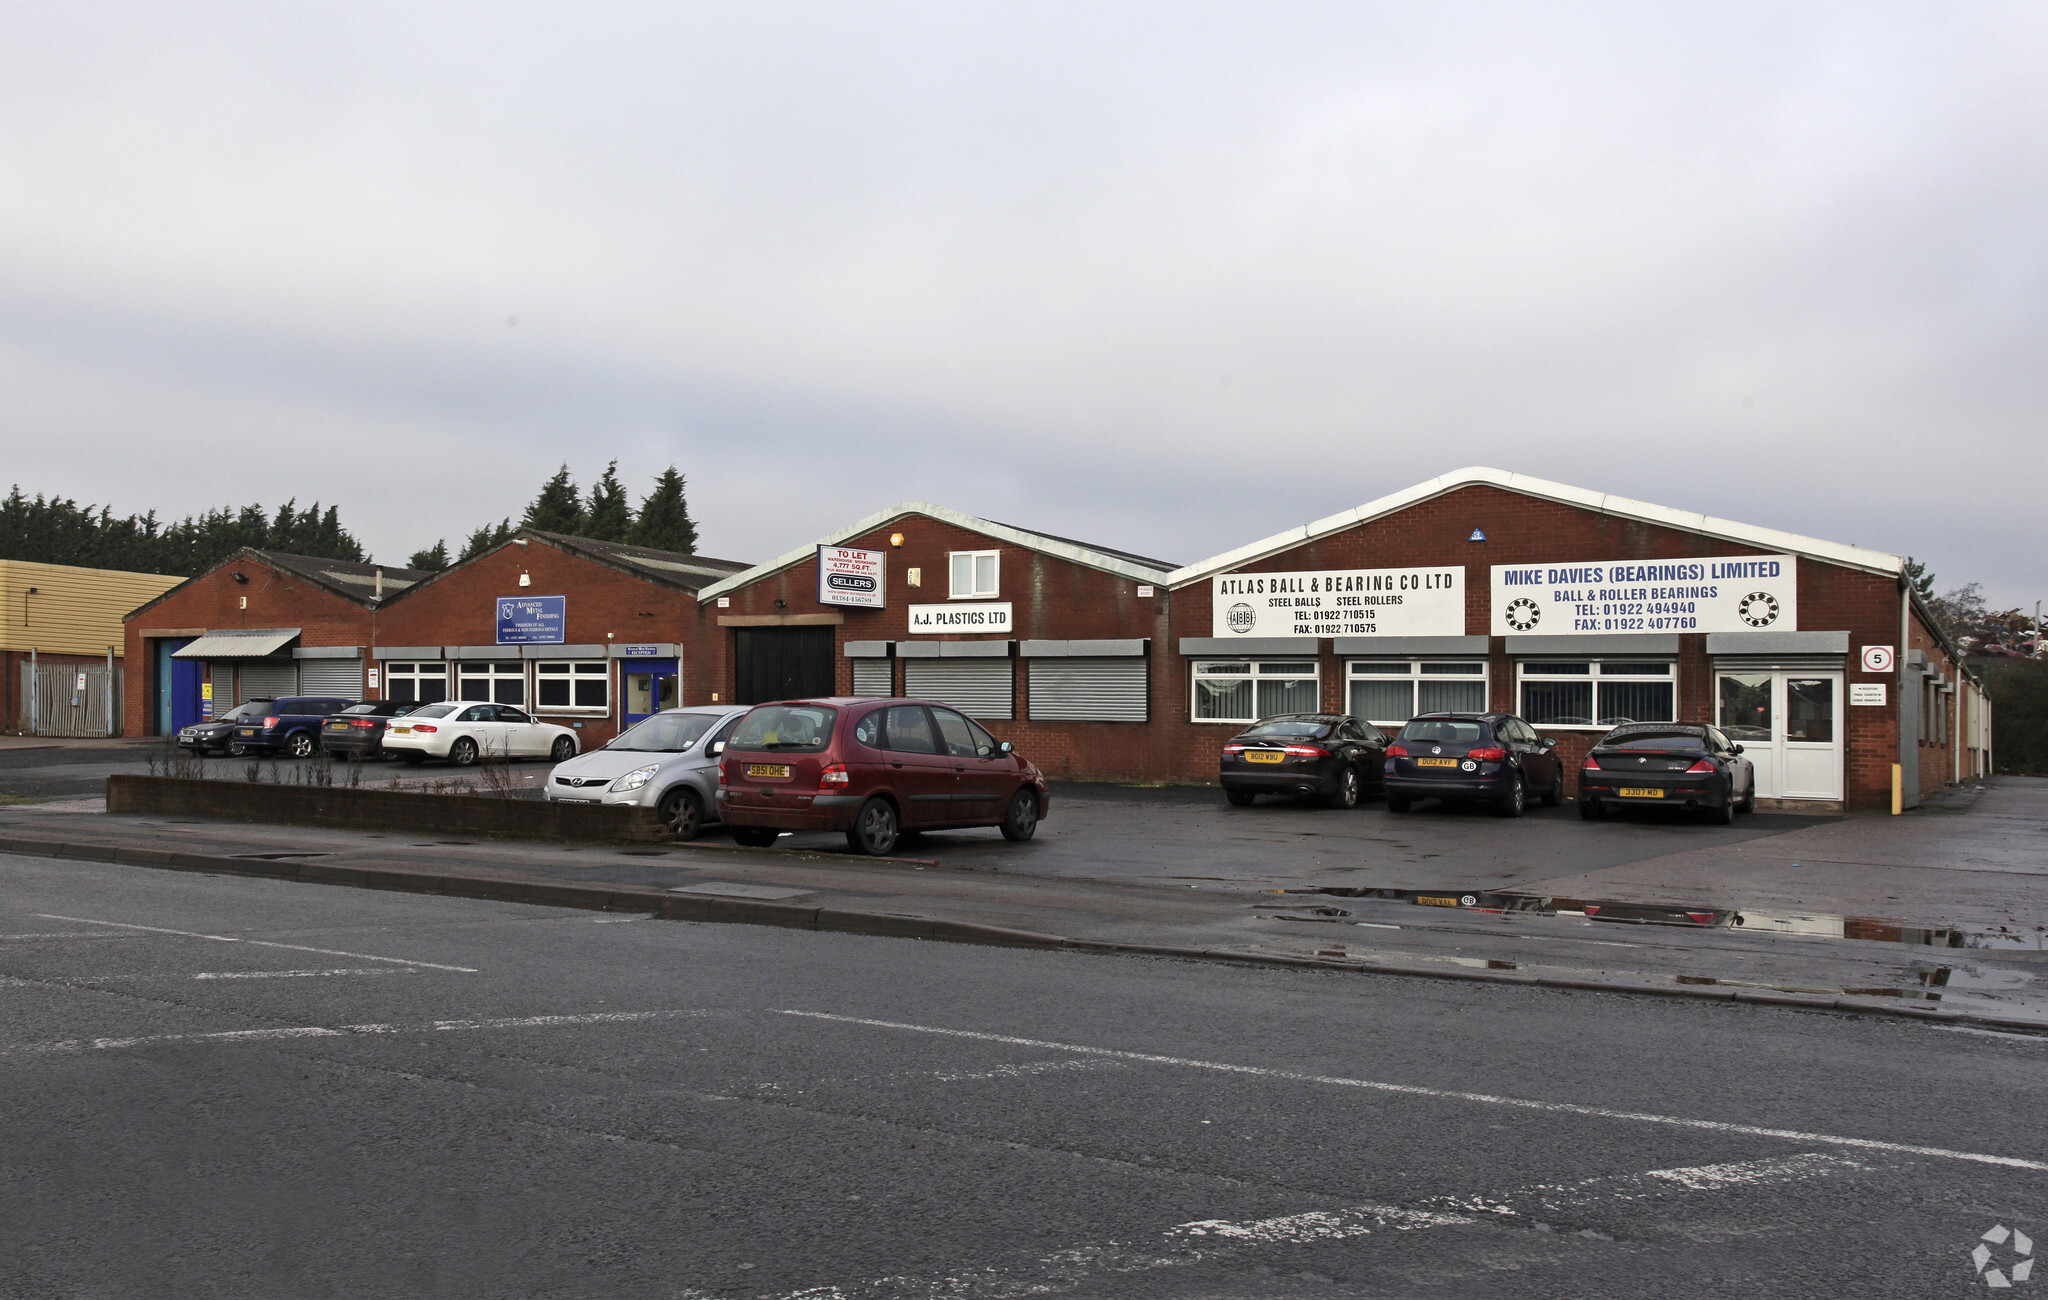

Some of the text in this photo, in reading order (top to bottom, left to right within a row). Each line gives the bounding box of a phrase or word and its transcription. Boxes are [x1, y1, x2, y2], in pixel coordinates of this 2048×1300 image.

[837, 550, 868, 560] TO LET
[1504, 561, 1780, 585] MIKE DAVIES (BEARINGS) LIMITED
[832, 577, 872, 588] SELLERS
[1221, 574, 1452, 595] ATLAS BALL & BEARING CO LTD
[1554, 586, 1718, 602] BALL & ROLLER BEARINGS
[1268, 597, 1321, 608] STEEL BALLS
[1336, 595, 1403, 606] STEEL ROLLERS
[1575, 602, 1695, 616] TEL: 01922 494940
[914, 612, 1006, 625] A.J. PLASTICS LTD
[1232, 612, 1250, 623] ABB
[1295, 609, 1375, 621] TEL: 01922 710515
[1574, 616, 1696, 630] FAX: 01922 407760
[1294, 624, 1376, 634] FAX: 01922 710575
[1874, 655, 1882, 663] 5
[751, 766, 768, 775] SB51
